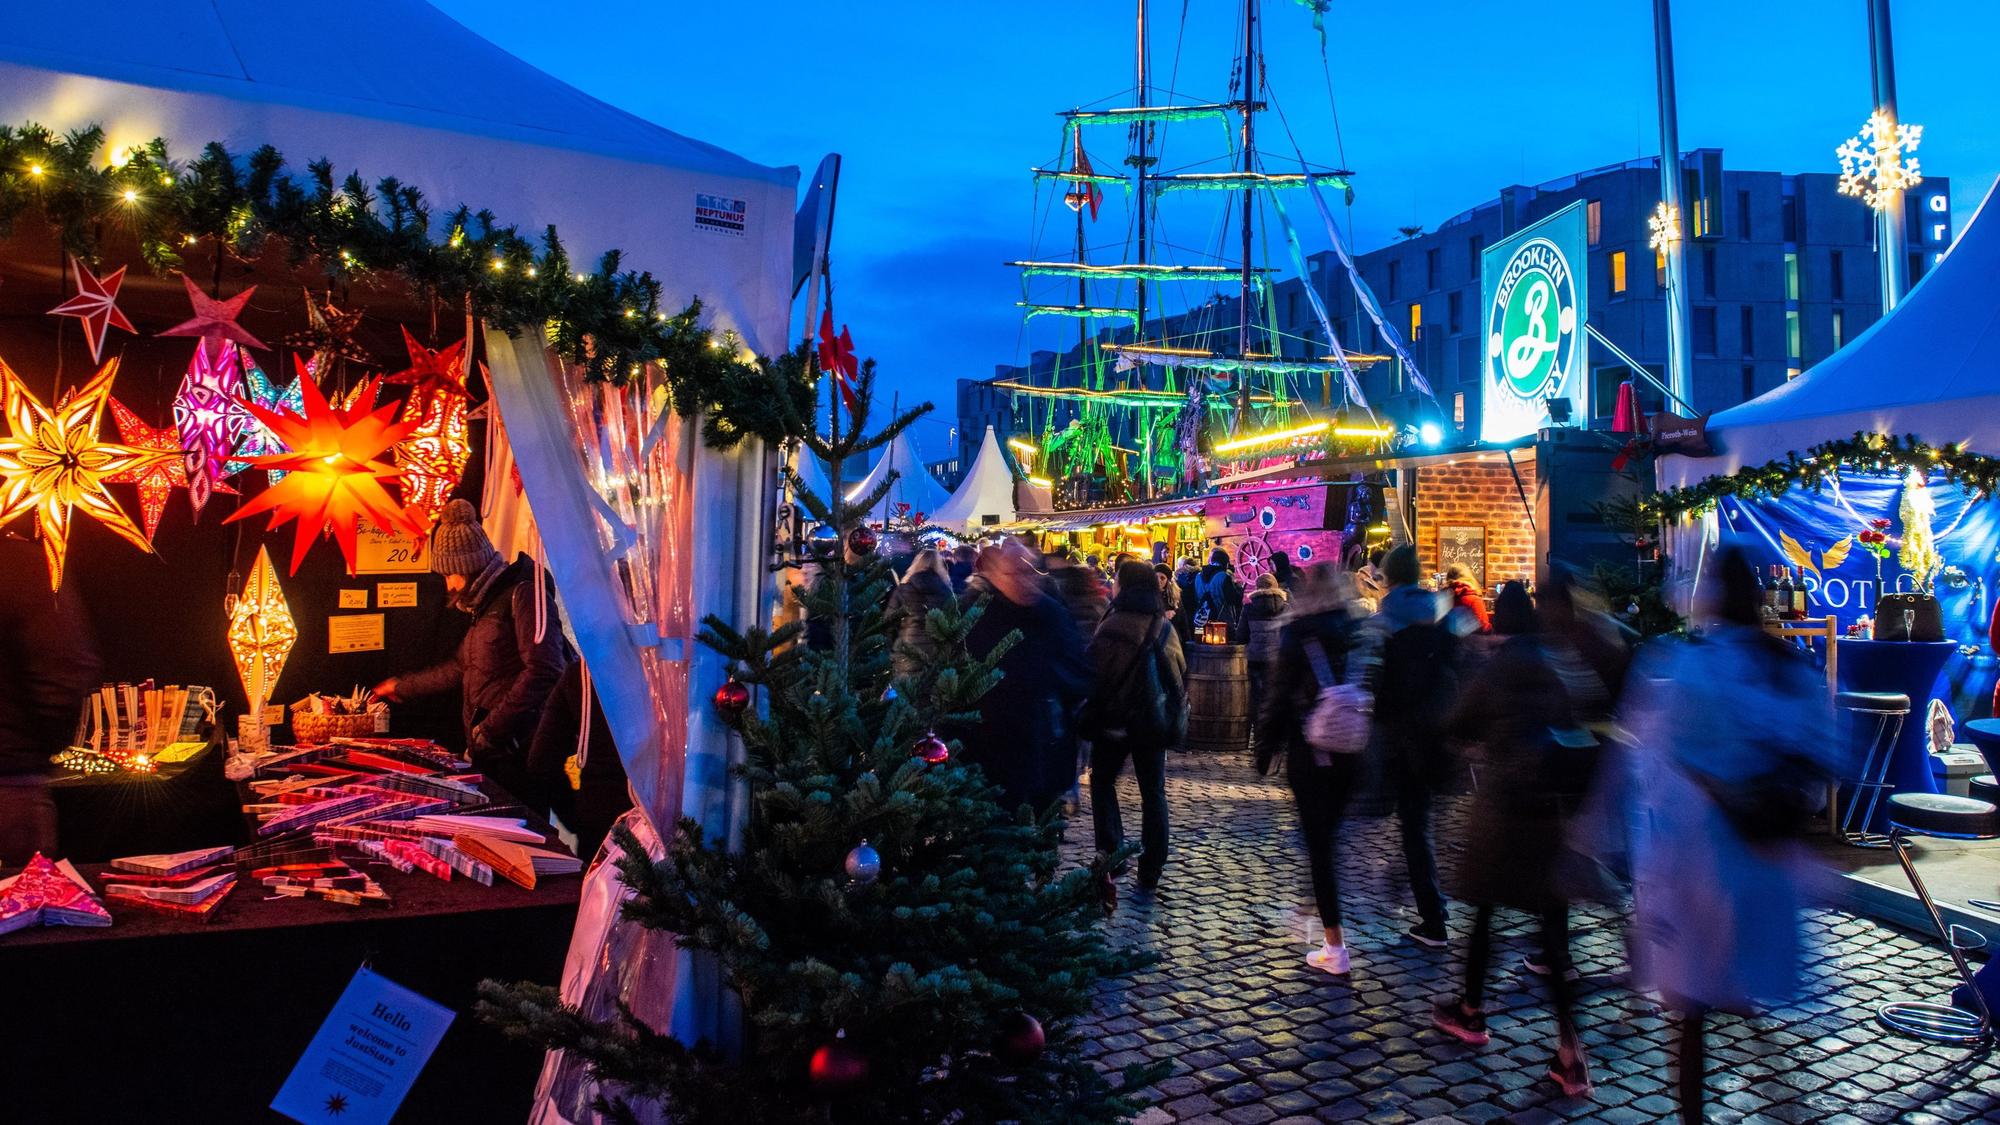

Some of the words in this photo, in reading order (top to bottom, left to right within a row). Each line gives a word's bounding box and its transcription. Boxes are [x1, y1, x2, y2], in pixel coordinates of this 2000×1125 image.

[695, 207, 745, 223] NEPTUNUS
[1497, 246, 1566, 310] BROOKLYN
[386, 548, 408, 563] 20
[371, 1002, 411, 1032] Hello
[345, 1035, 396, 1066] JustStars
[349, 1023, 394, 1050] welcome
[395, 1045, 407, 1057] to
